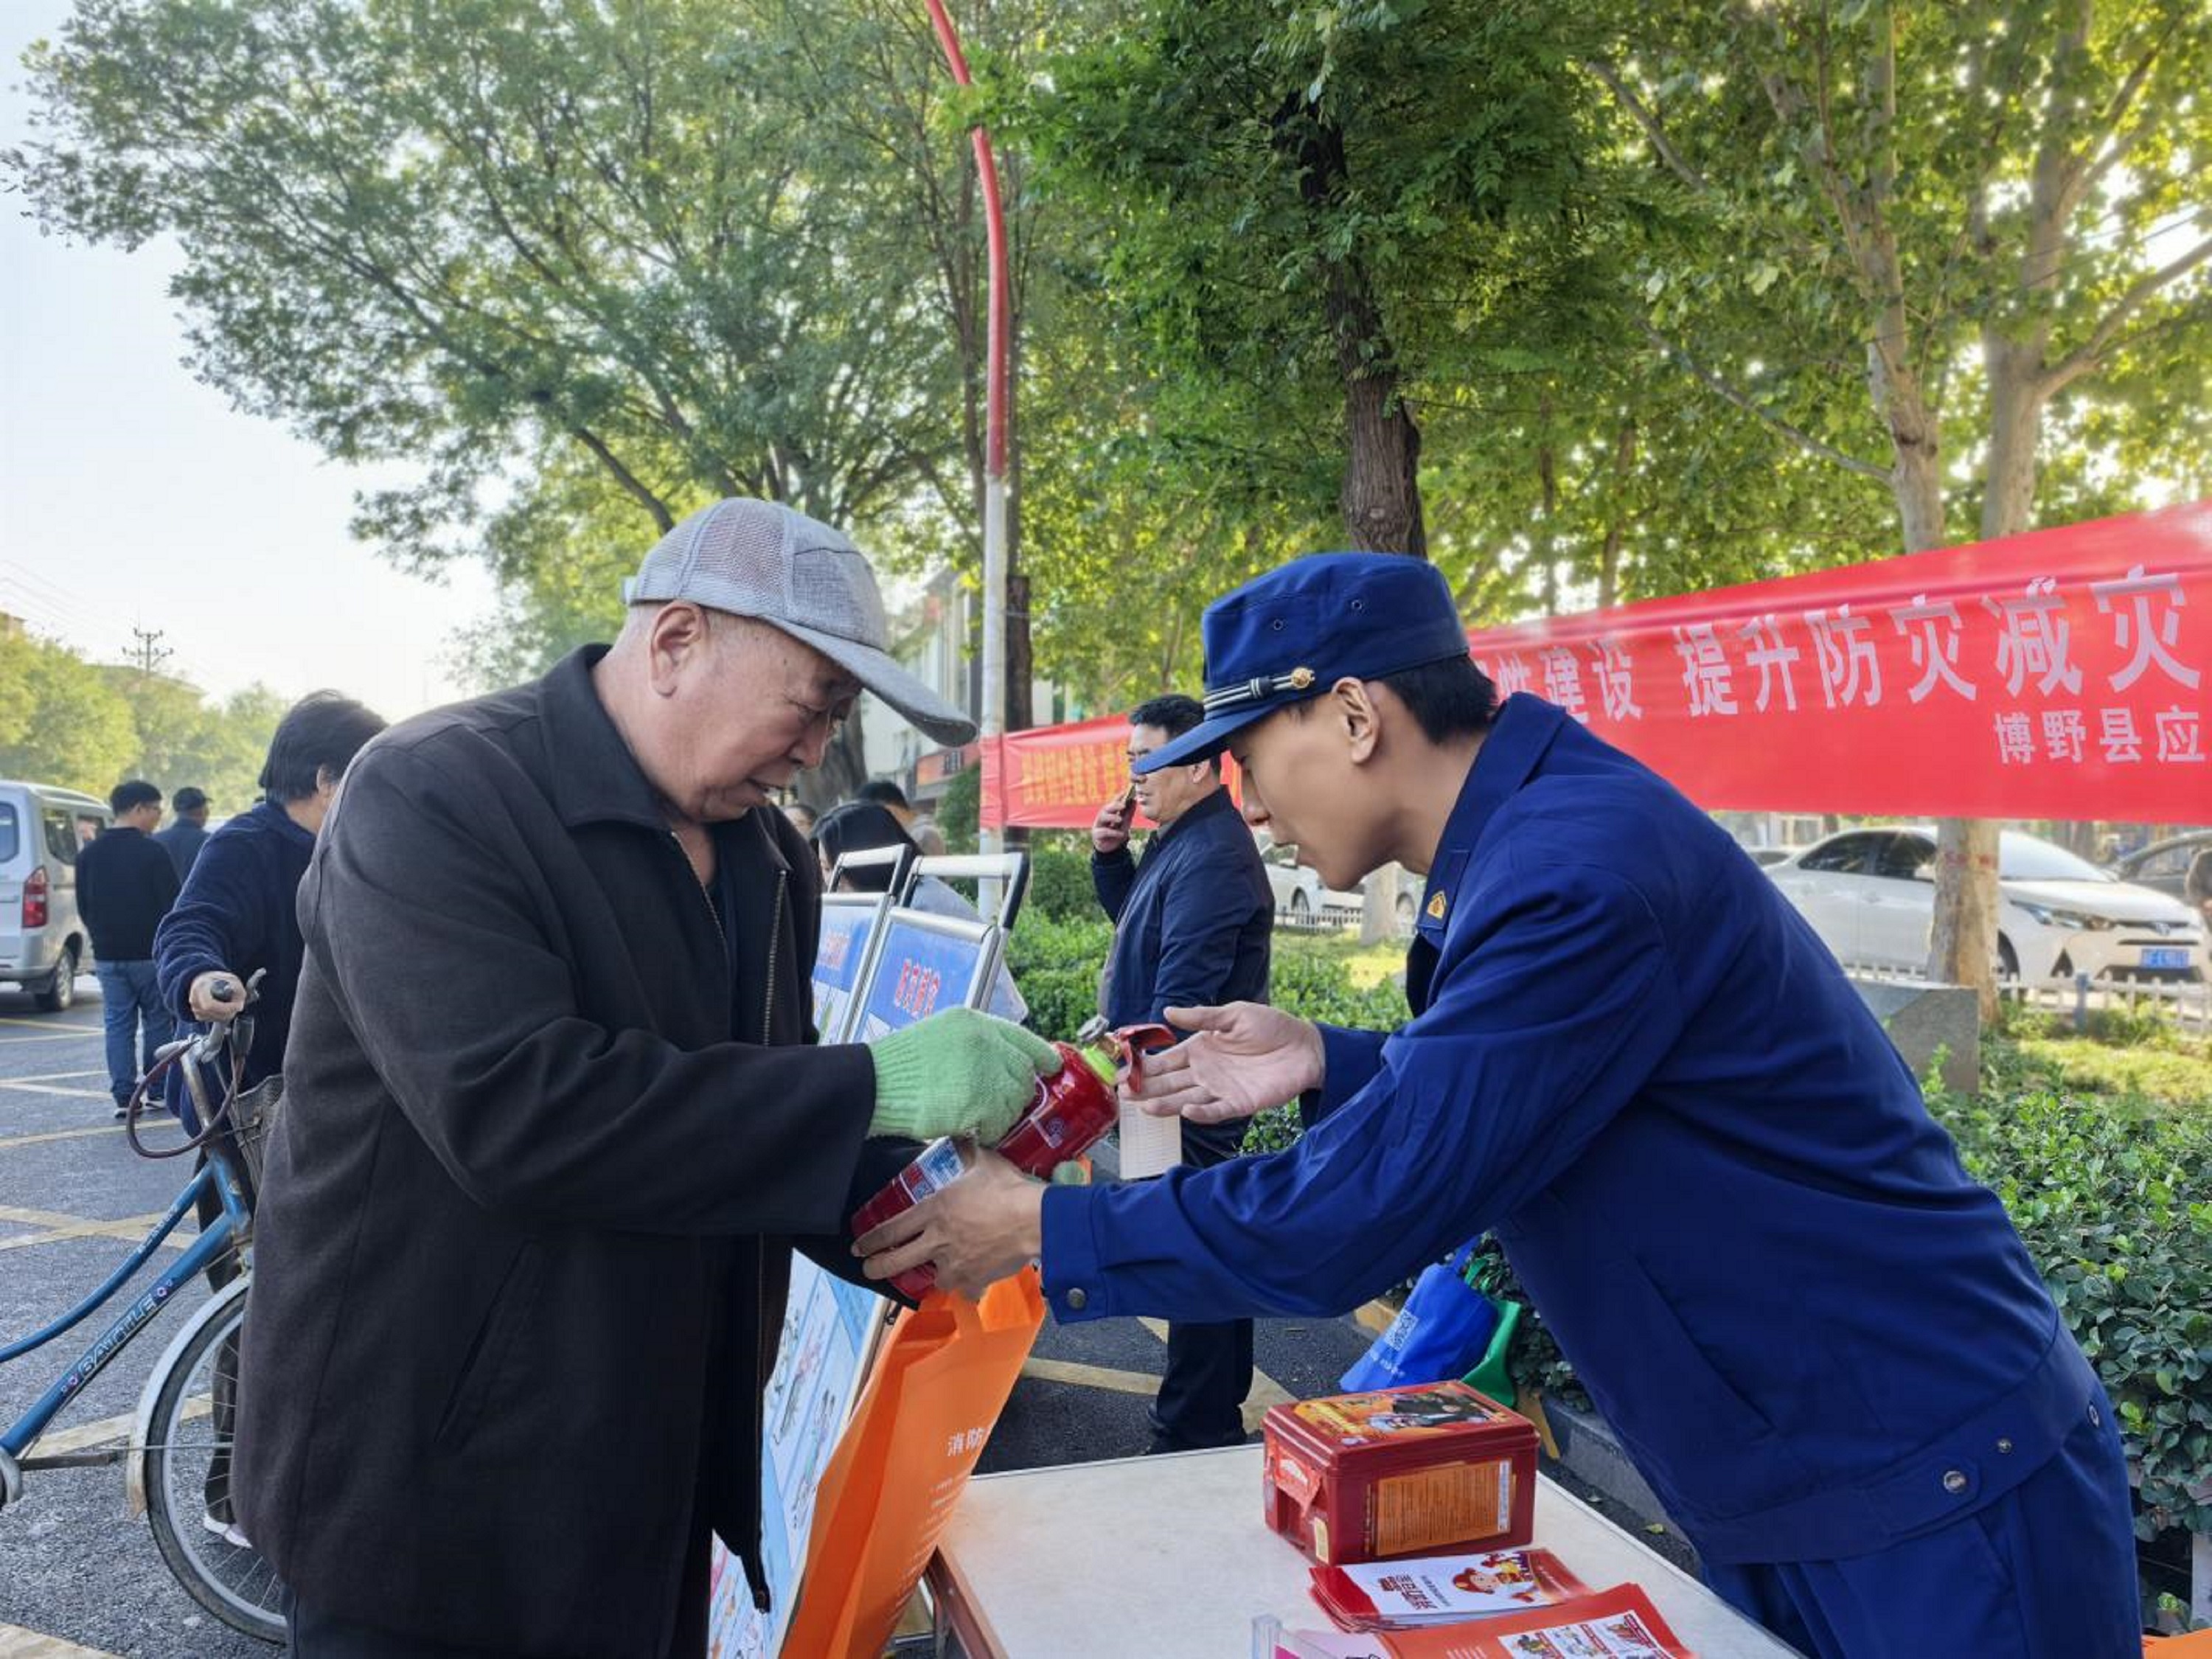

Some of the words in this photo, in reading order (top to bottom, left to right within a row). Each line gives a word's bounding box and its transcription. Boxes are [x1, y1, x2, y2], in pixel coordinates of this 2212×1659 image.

[1475, 635, 1644, 723] 性建设
[1673, 564, 2200, 718] 提升防灾减灾
[1994, 704, 2205, 764] 博野县应
